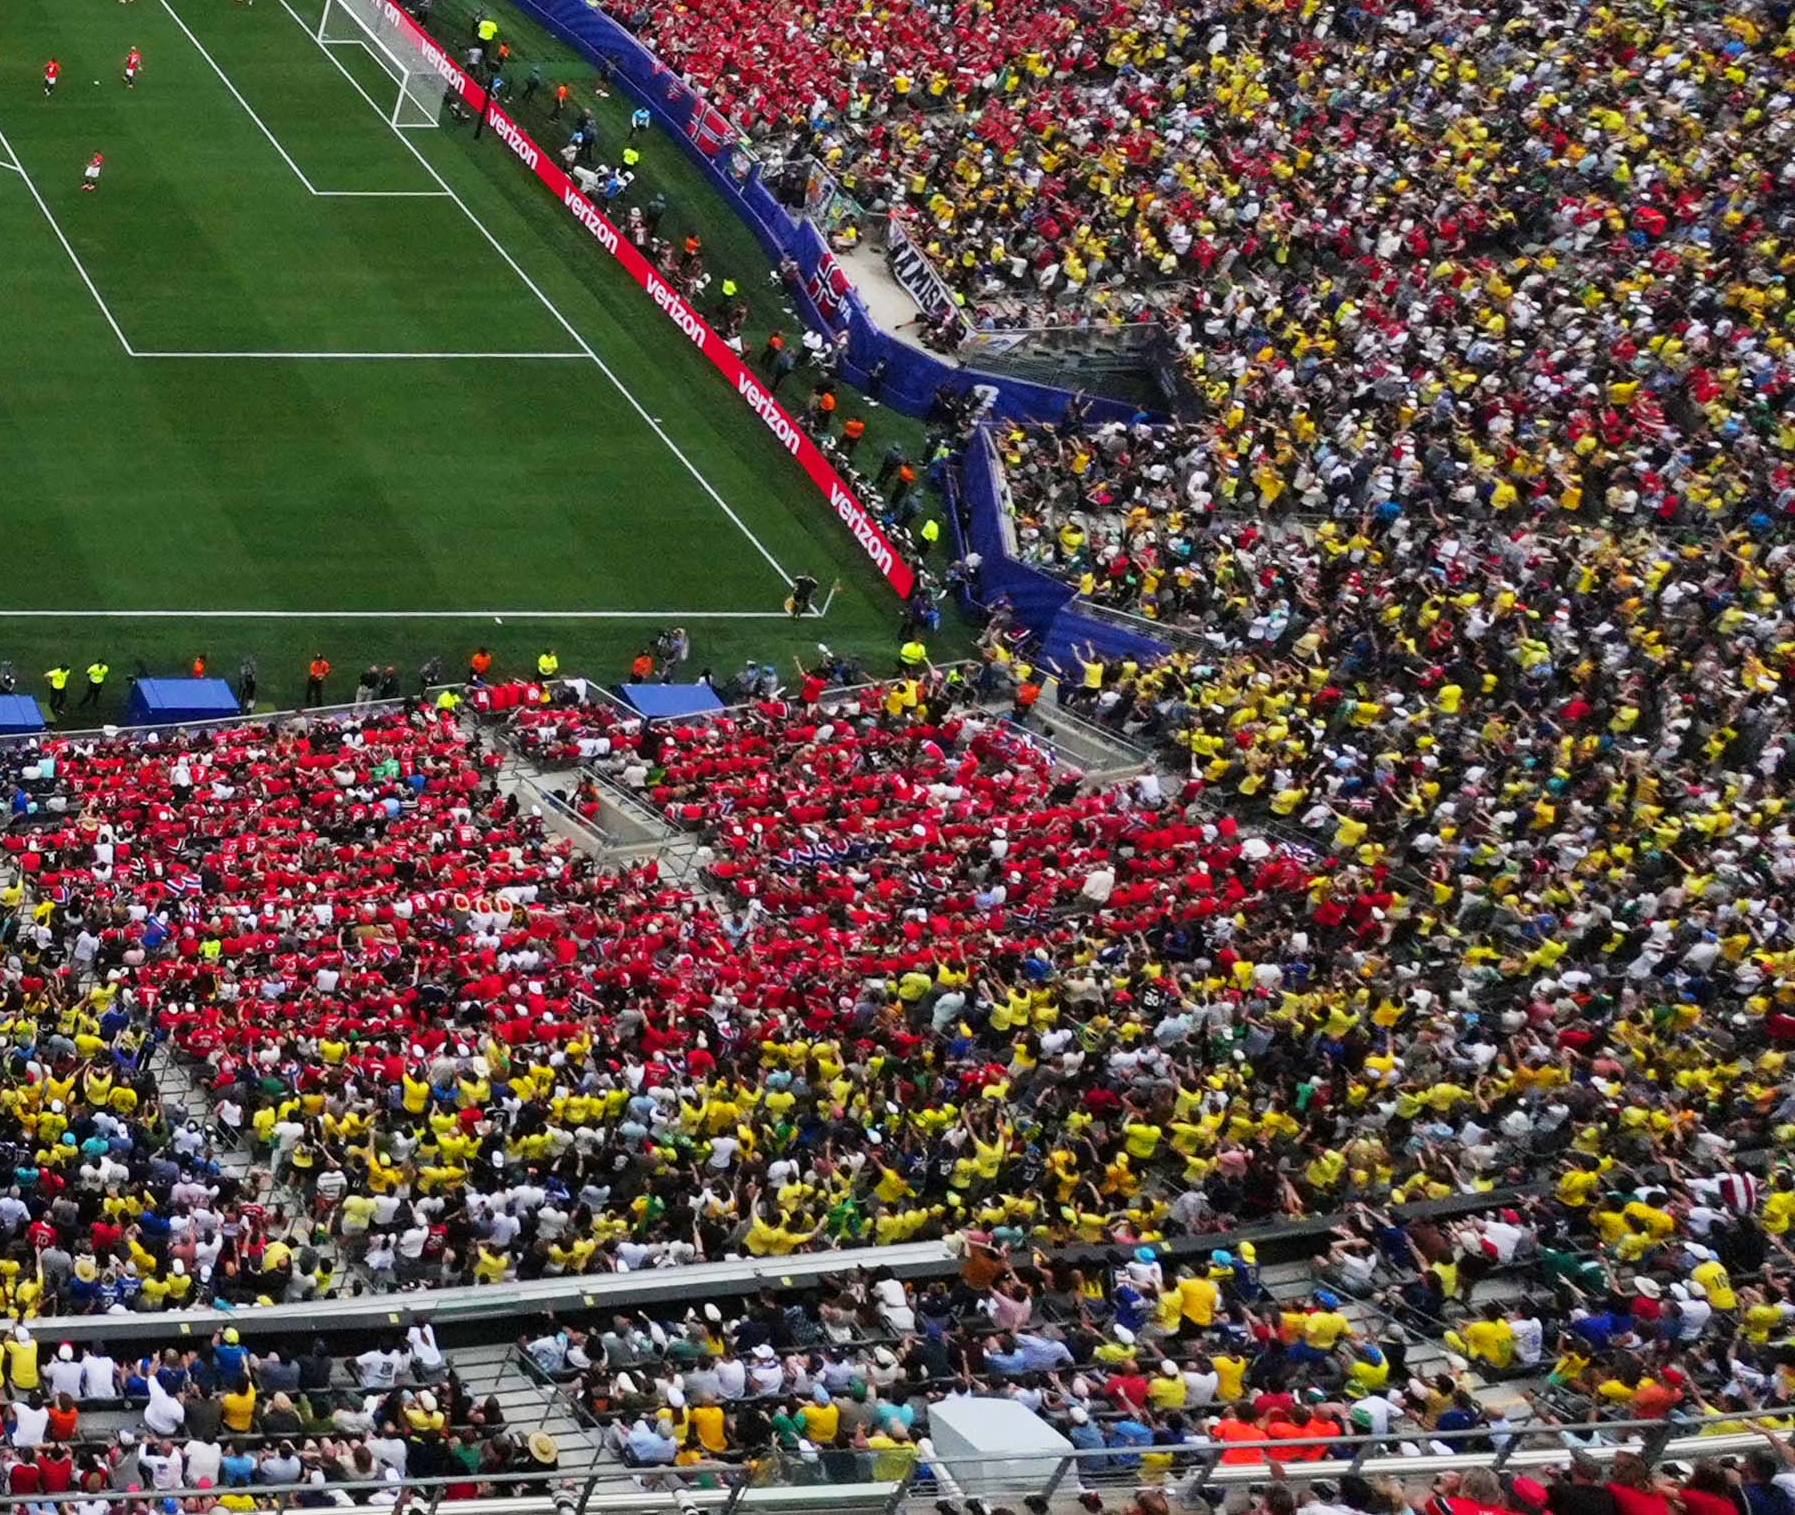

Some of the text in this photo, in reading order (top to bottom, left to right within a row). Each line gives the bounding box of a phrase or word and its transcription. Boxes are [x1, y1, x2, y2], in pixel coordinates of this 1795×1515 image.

[420, 38, 466, 93] verizon
[489, 107, 538, 169] verizon
[564, 185, 619, 254] verizon
[645, 272, 707, 347] verizon
[738, 371, 800, 454] verizon
[830, 481, 894, 575] verizon
